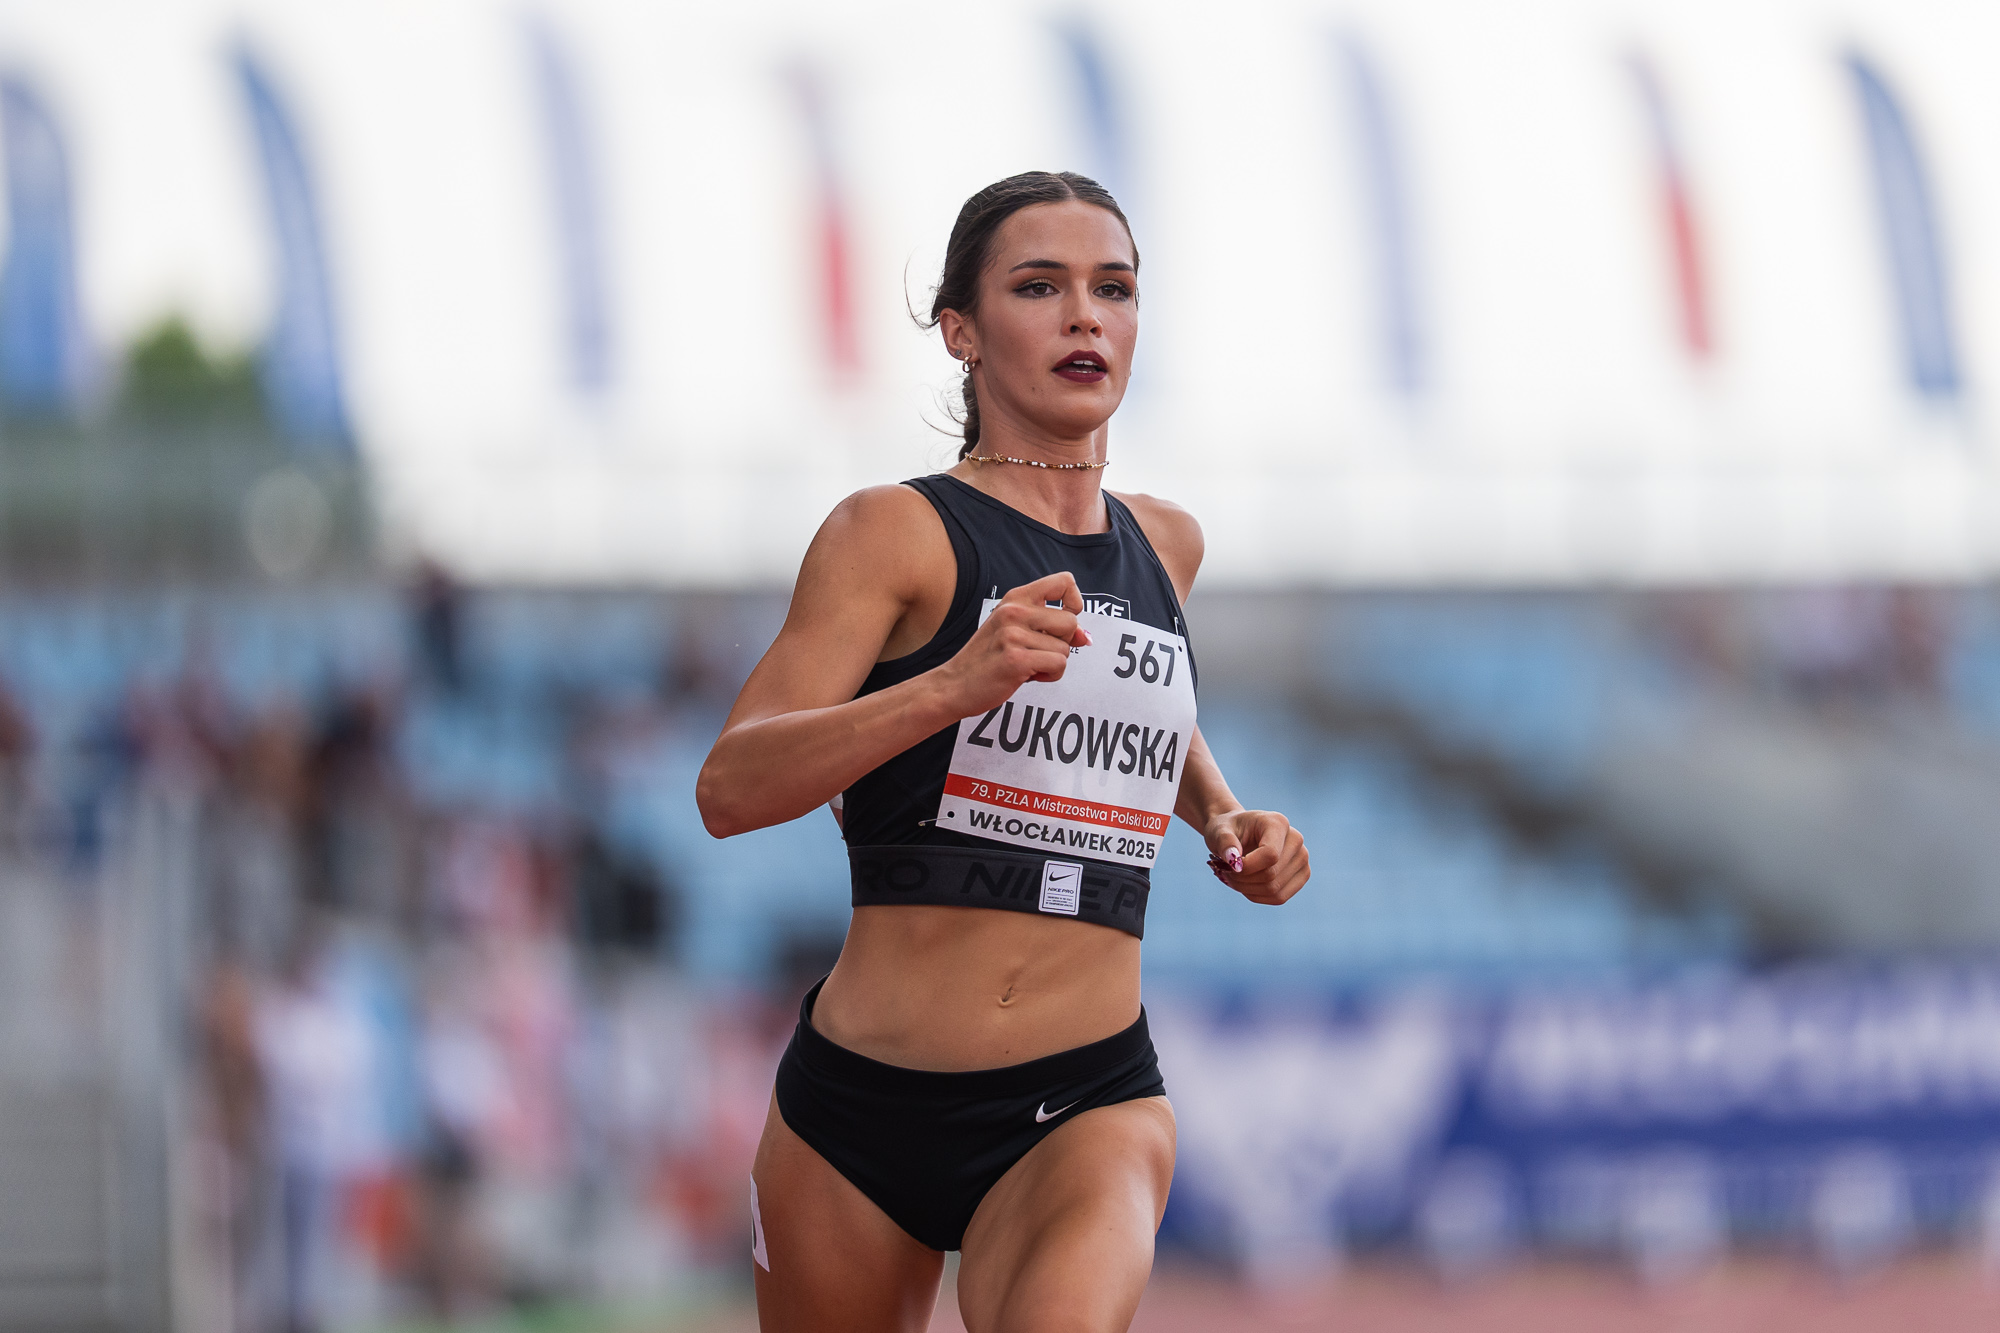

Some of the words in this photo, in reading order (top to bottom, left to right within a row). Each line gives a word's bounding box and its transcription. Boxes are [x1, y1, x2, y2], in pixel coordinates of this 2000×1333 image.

[1082, 600, 1124, 618] IKE
[1113, 633, 1175, 687] 567
[971, 782, 991, 799] 79.
[995, 788, 1029, 807] PZLA
[1033, 797, 1107, 821] Mistrzostwa
[1111, 810, 1141, 828] Polski
[1142, 815, 1162, 831] U20
[969, 808, 1113, 853] WŁOCŁAWEK
[1116, 837, 1156, 860] 2025
